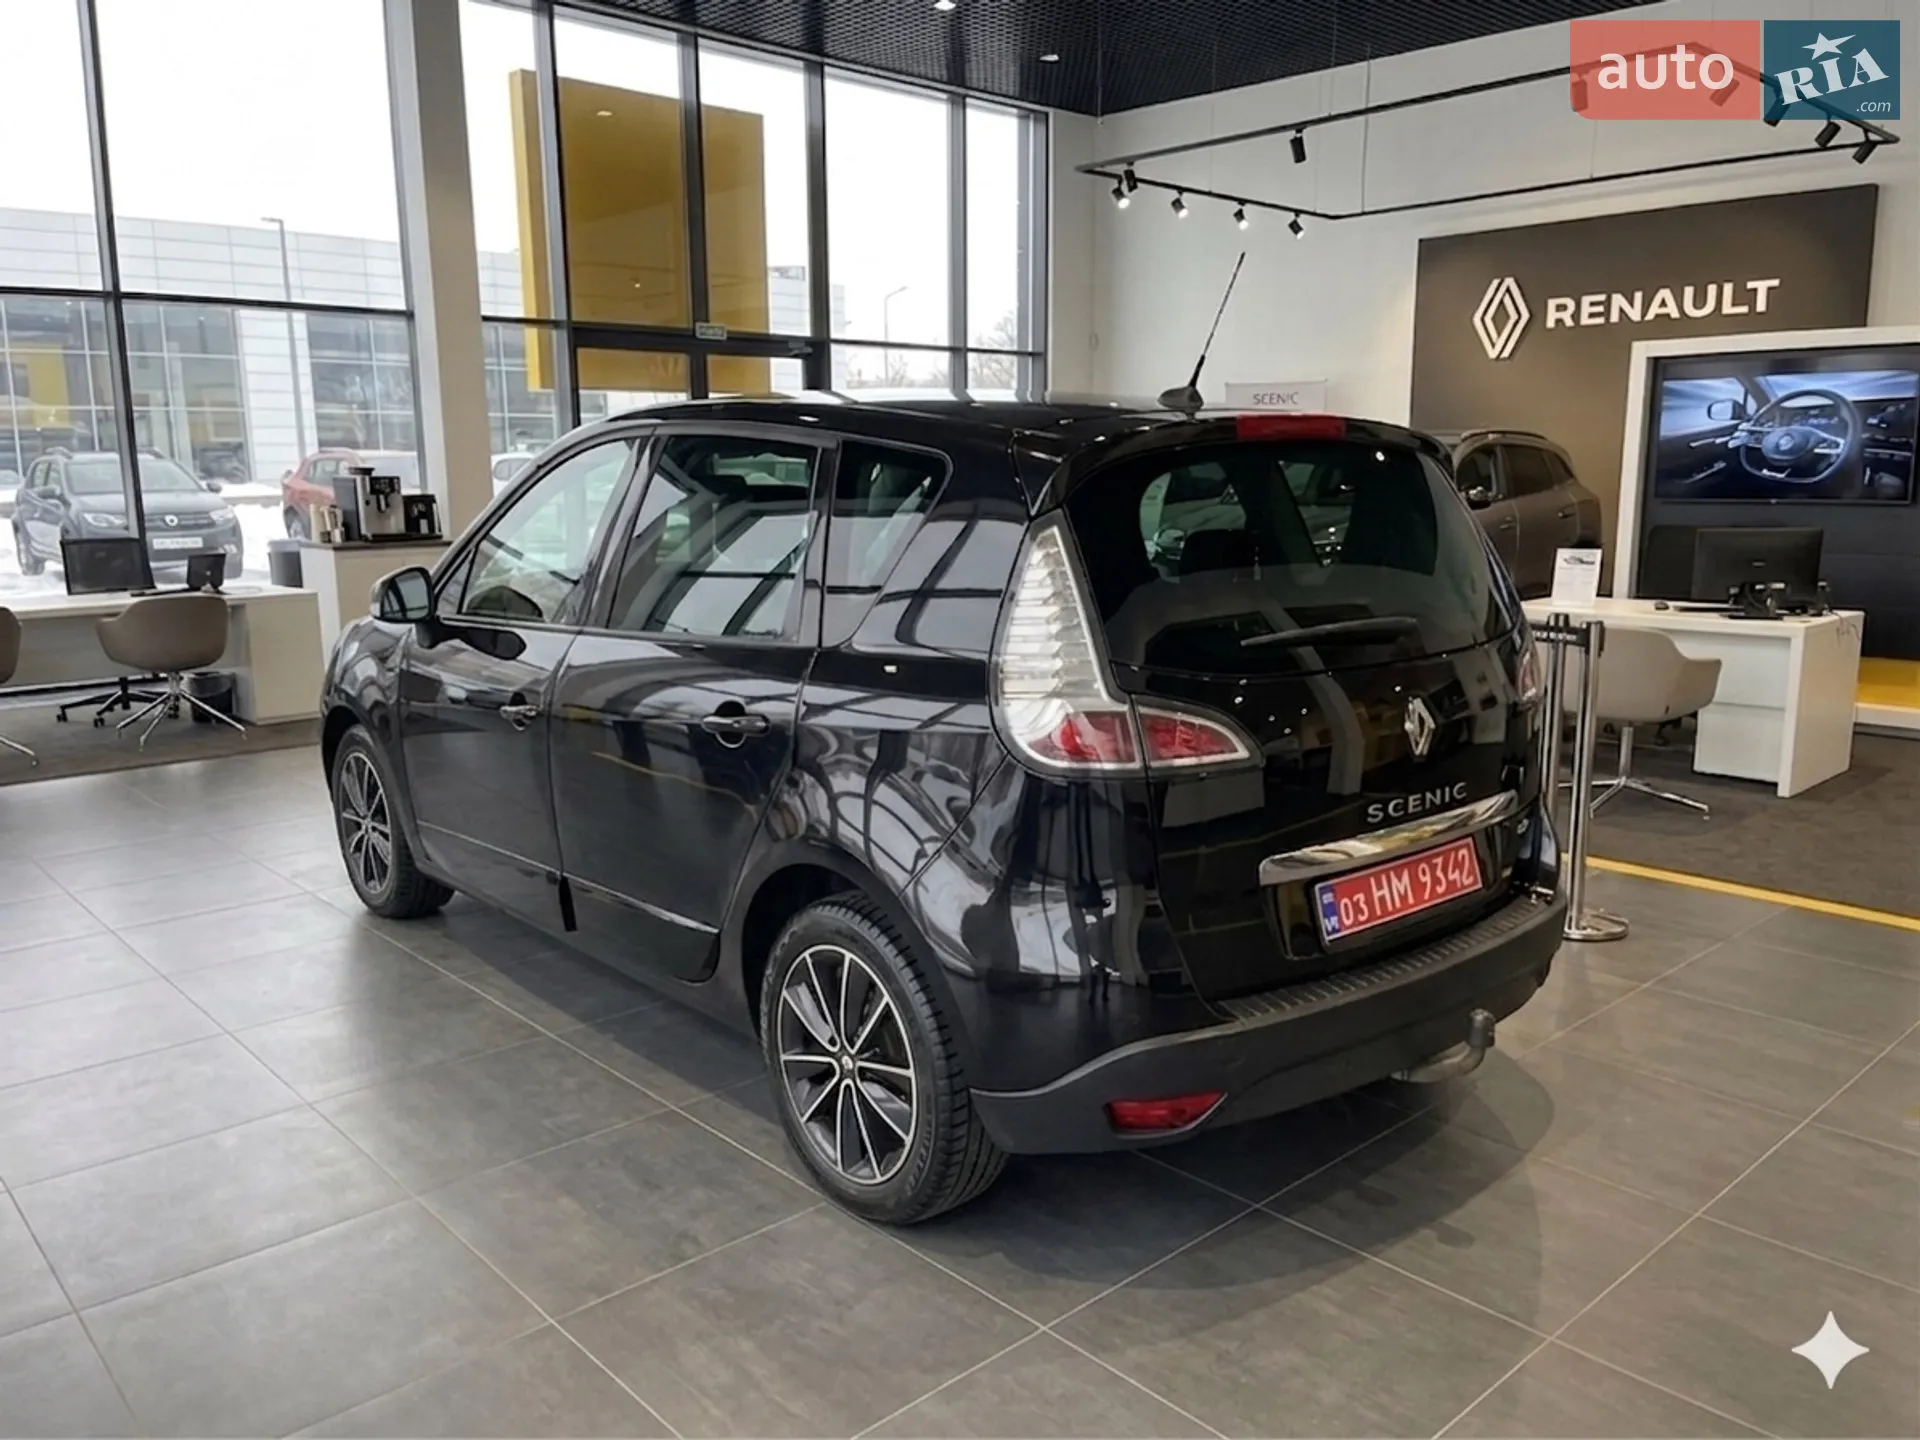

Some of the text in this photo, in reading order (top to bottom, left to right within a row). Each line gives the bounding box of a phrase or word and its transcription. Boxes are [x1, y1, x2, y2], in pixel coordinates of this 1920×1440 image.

[1546, 278, 1780, 329] RENAULT
[1366, 782, 1467, 823] SCENIC
[1339, 848, 1475, 926] 03 HM 9342
